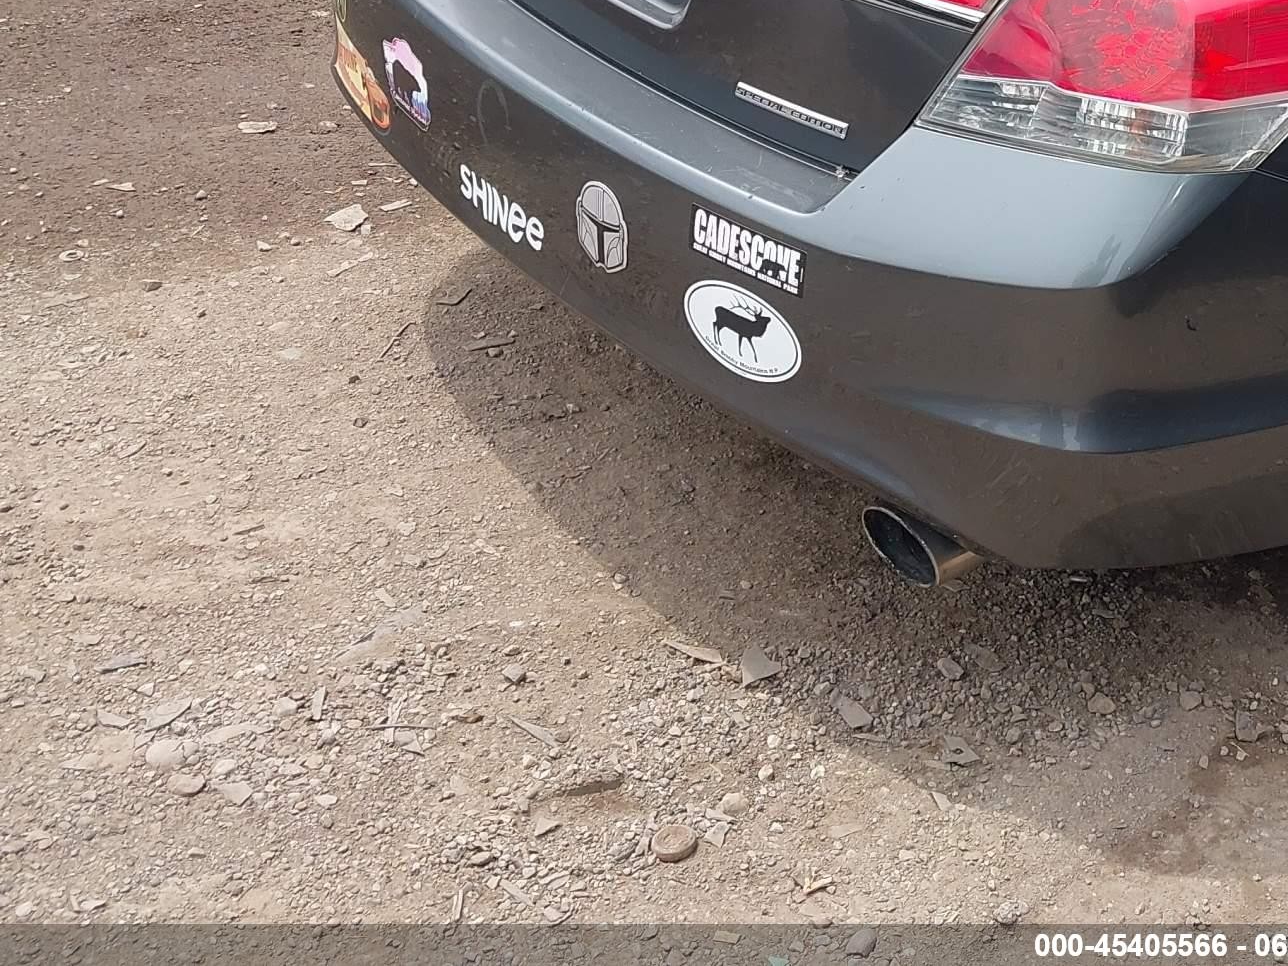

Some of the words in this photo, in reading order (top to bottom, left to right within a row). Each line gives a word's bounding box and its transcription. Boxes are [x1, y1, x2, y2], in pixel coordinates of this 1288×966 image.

[736, 86, 786, 112] SPECIAL
[791, 110, 844, 135] EDITION
[460, 164, 545, 251] SHINee
